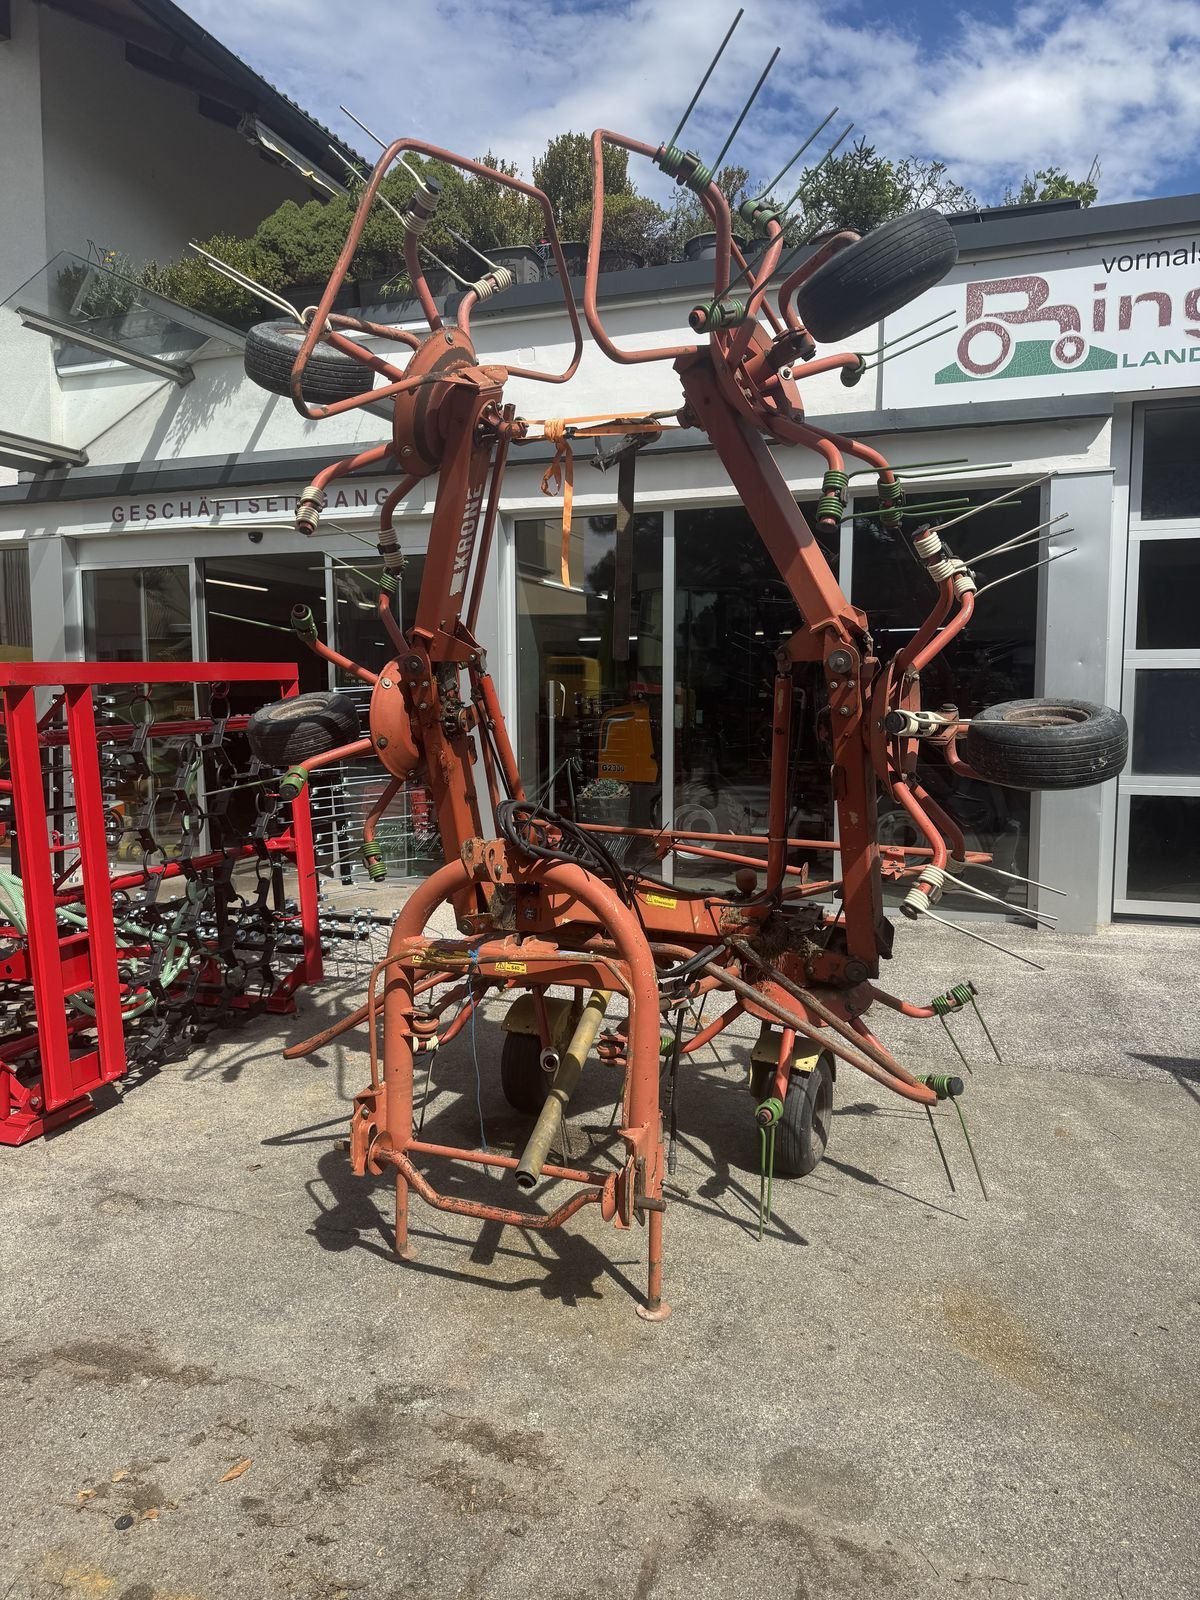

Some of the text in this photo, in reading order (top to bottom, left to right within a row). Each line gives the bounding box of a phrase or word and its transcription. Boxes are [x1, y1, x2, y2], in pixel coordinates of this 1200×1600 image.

[1101, 241, 1200, 274] vormal
[112, 487, 389, 523] GESCHÄFTSEIGANG
[453, 483, 483, 571] KRONE
